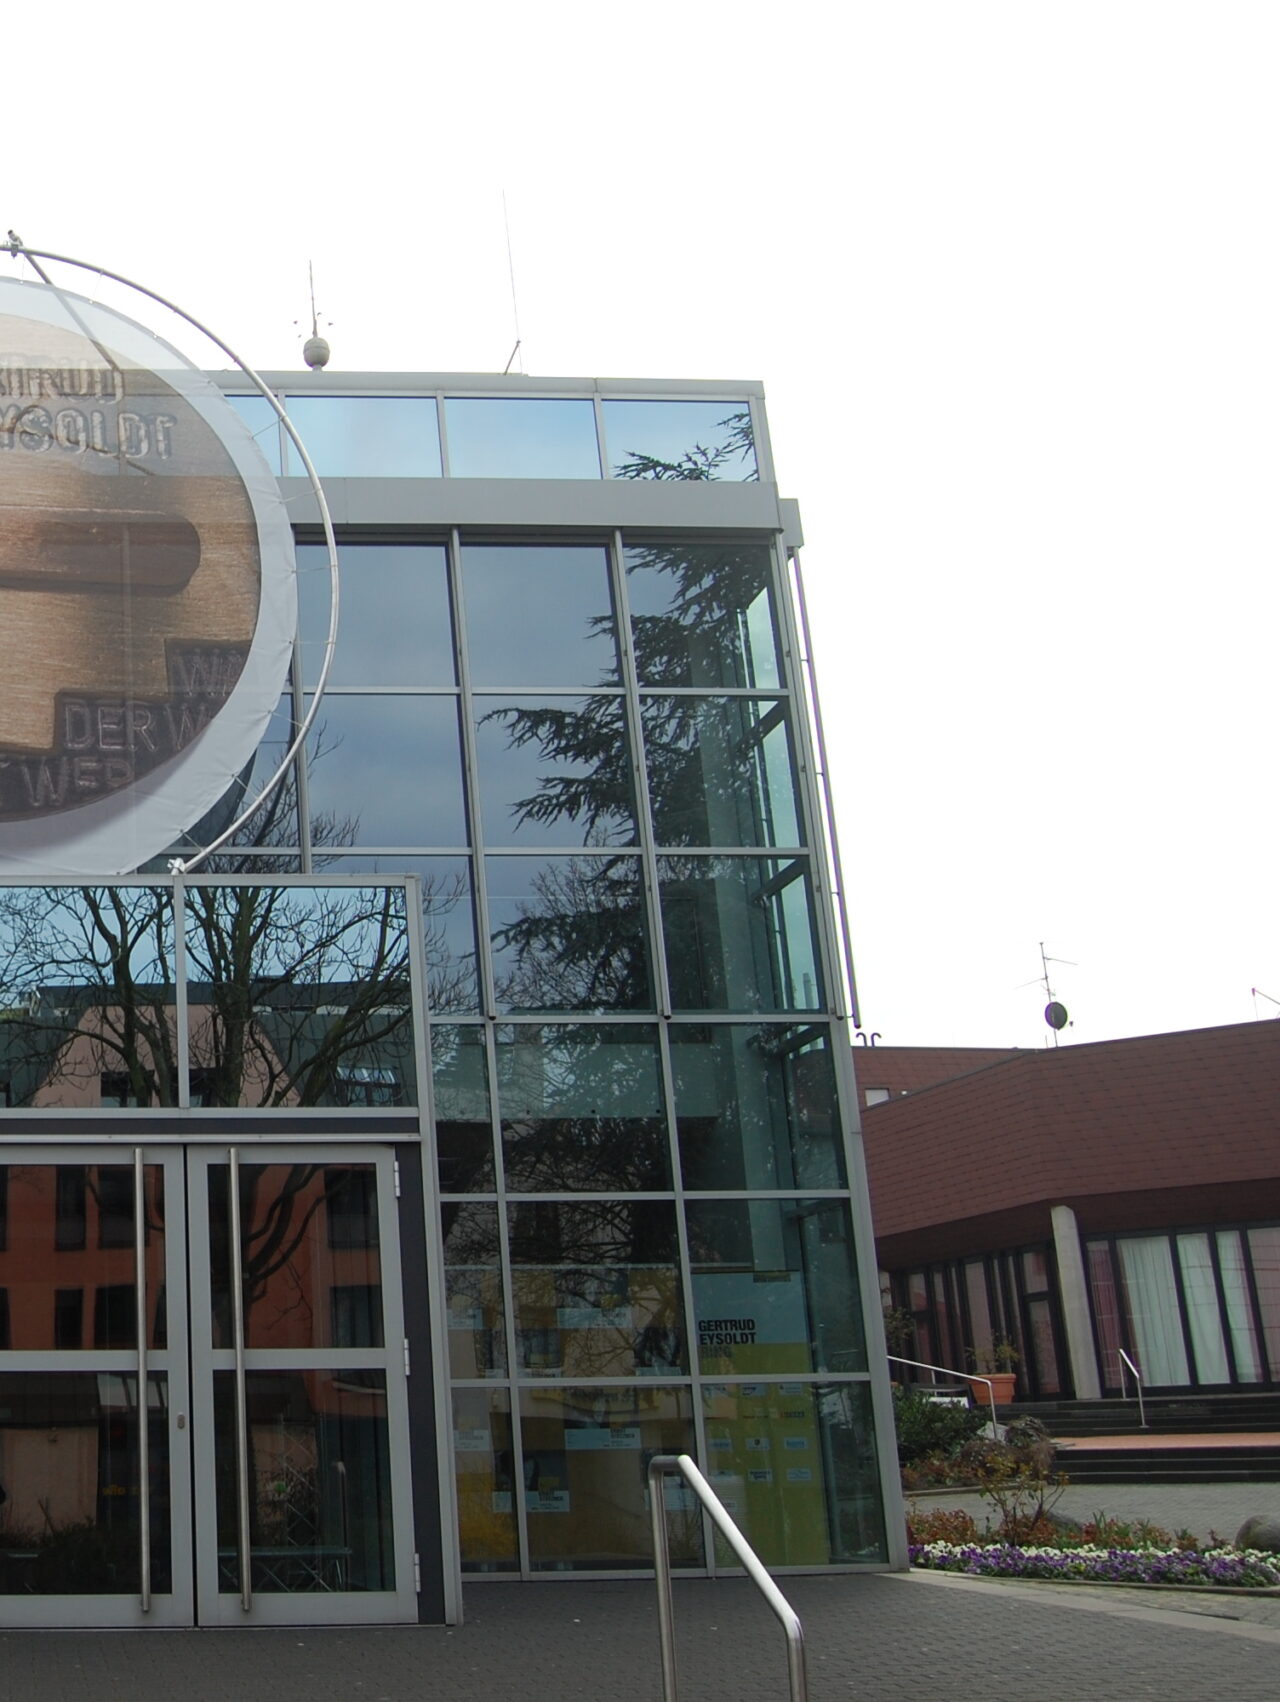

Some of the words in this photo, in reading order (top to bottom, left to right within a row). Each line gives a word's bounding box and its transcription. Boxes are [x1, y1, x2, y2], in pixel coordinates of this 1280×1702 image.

[63, 697, 158, 751] DER
[698, 1319, 755, 1331] GERTRUD
[699, 1332, 756, 1345] EYSOLDT
